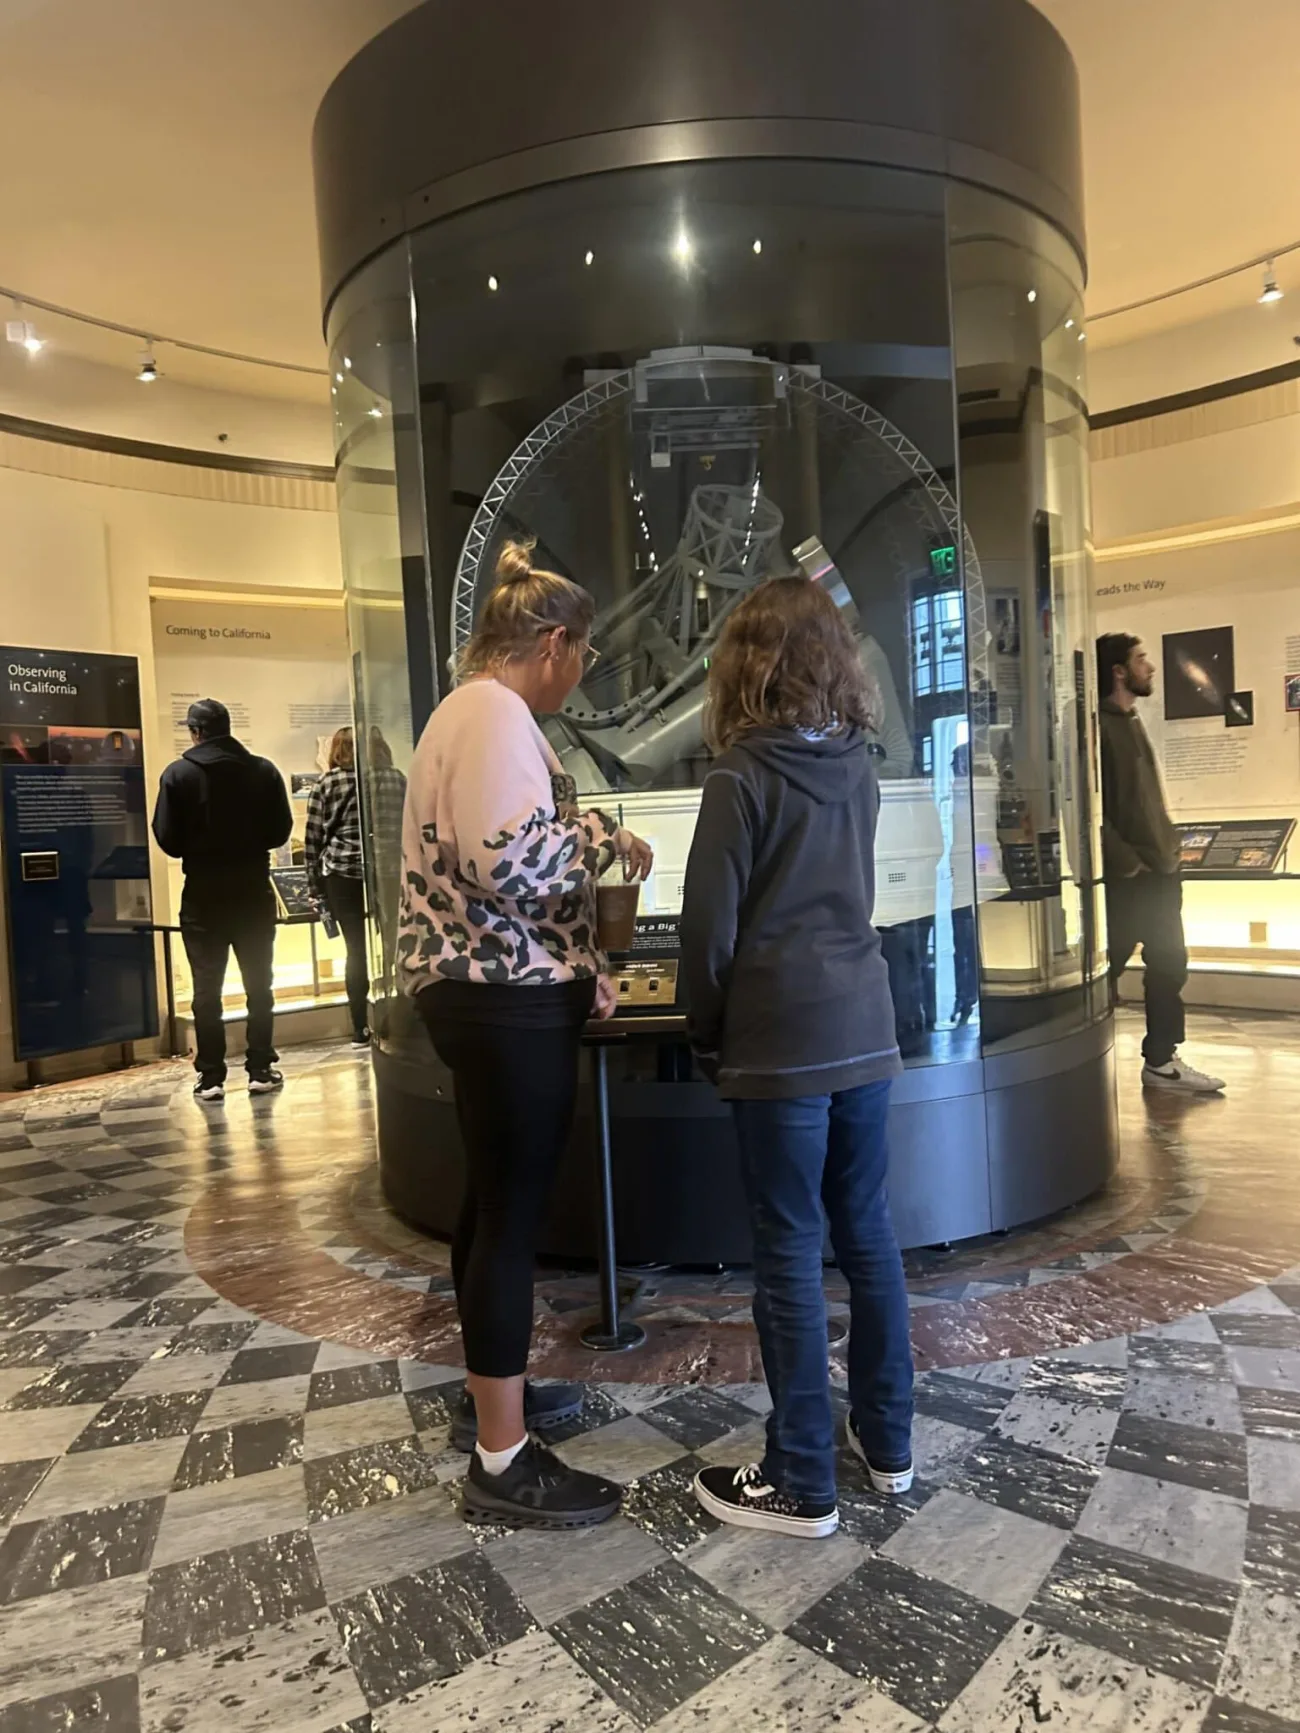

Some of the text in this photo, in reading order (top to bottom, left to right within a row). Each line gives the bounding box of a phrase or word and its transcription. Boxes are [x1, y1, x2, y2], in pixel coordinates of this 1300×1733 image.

[1096, 579, 1166, 596] eads the Way
[166, 625, 271, 640] Coming to California
[8, 664, 67, 682] Observing
[9, 680, 77, 695] in California
[658, 922, 676, 932] Big
